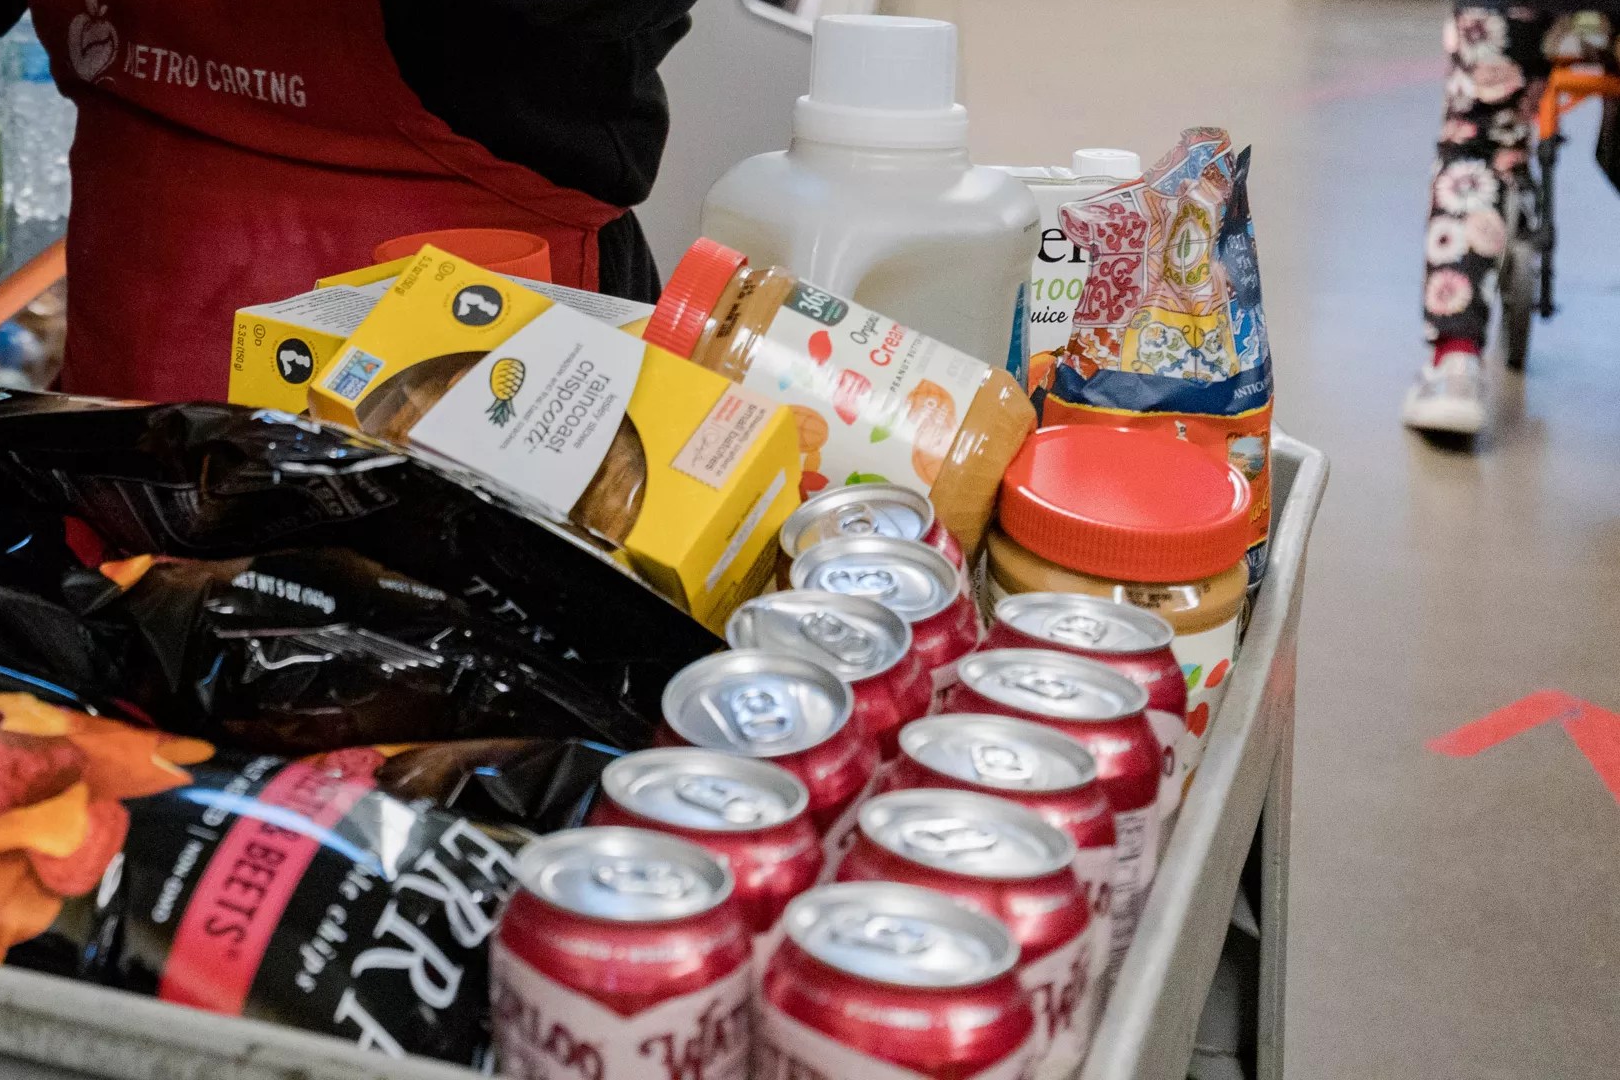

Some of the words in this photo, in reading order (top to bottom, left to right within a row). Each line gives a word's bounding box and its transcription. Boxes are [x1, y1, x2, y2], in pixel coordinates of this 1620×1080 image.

[204, 59, 307, 108] CARING
[797, 286, 831, 319] 365
[1031, 277, 1084, 302] 100
[890, 356, 912, 393] PEANUT
[544, 373, 612, 455] raincoast
[592, 392, 618, 422] lesley
[734, 403, 758, 431] small
[572, 421, 598, 450] stowe
[704, 430, 740, 472] batches
[256, 573, 276, 595] WT
[275, 578, 286, 599] 5
[285, 581, 302, 603] OZ
[205, 839, 288, 946] BEETS
[294, 903, 348, 994] chips
